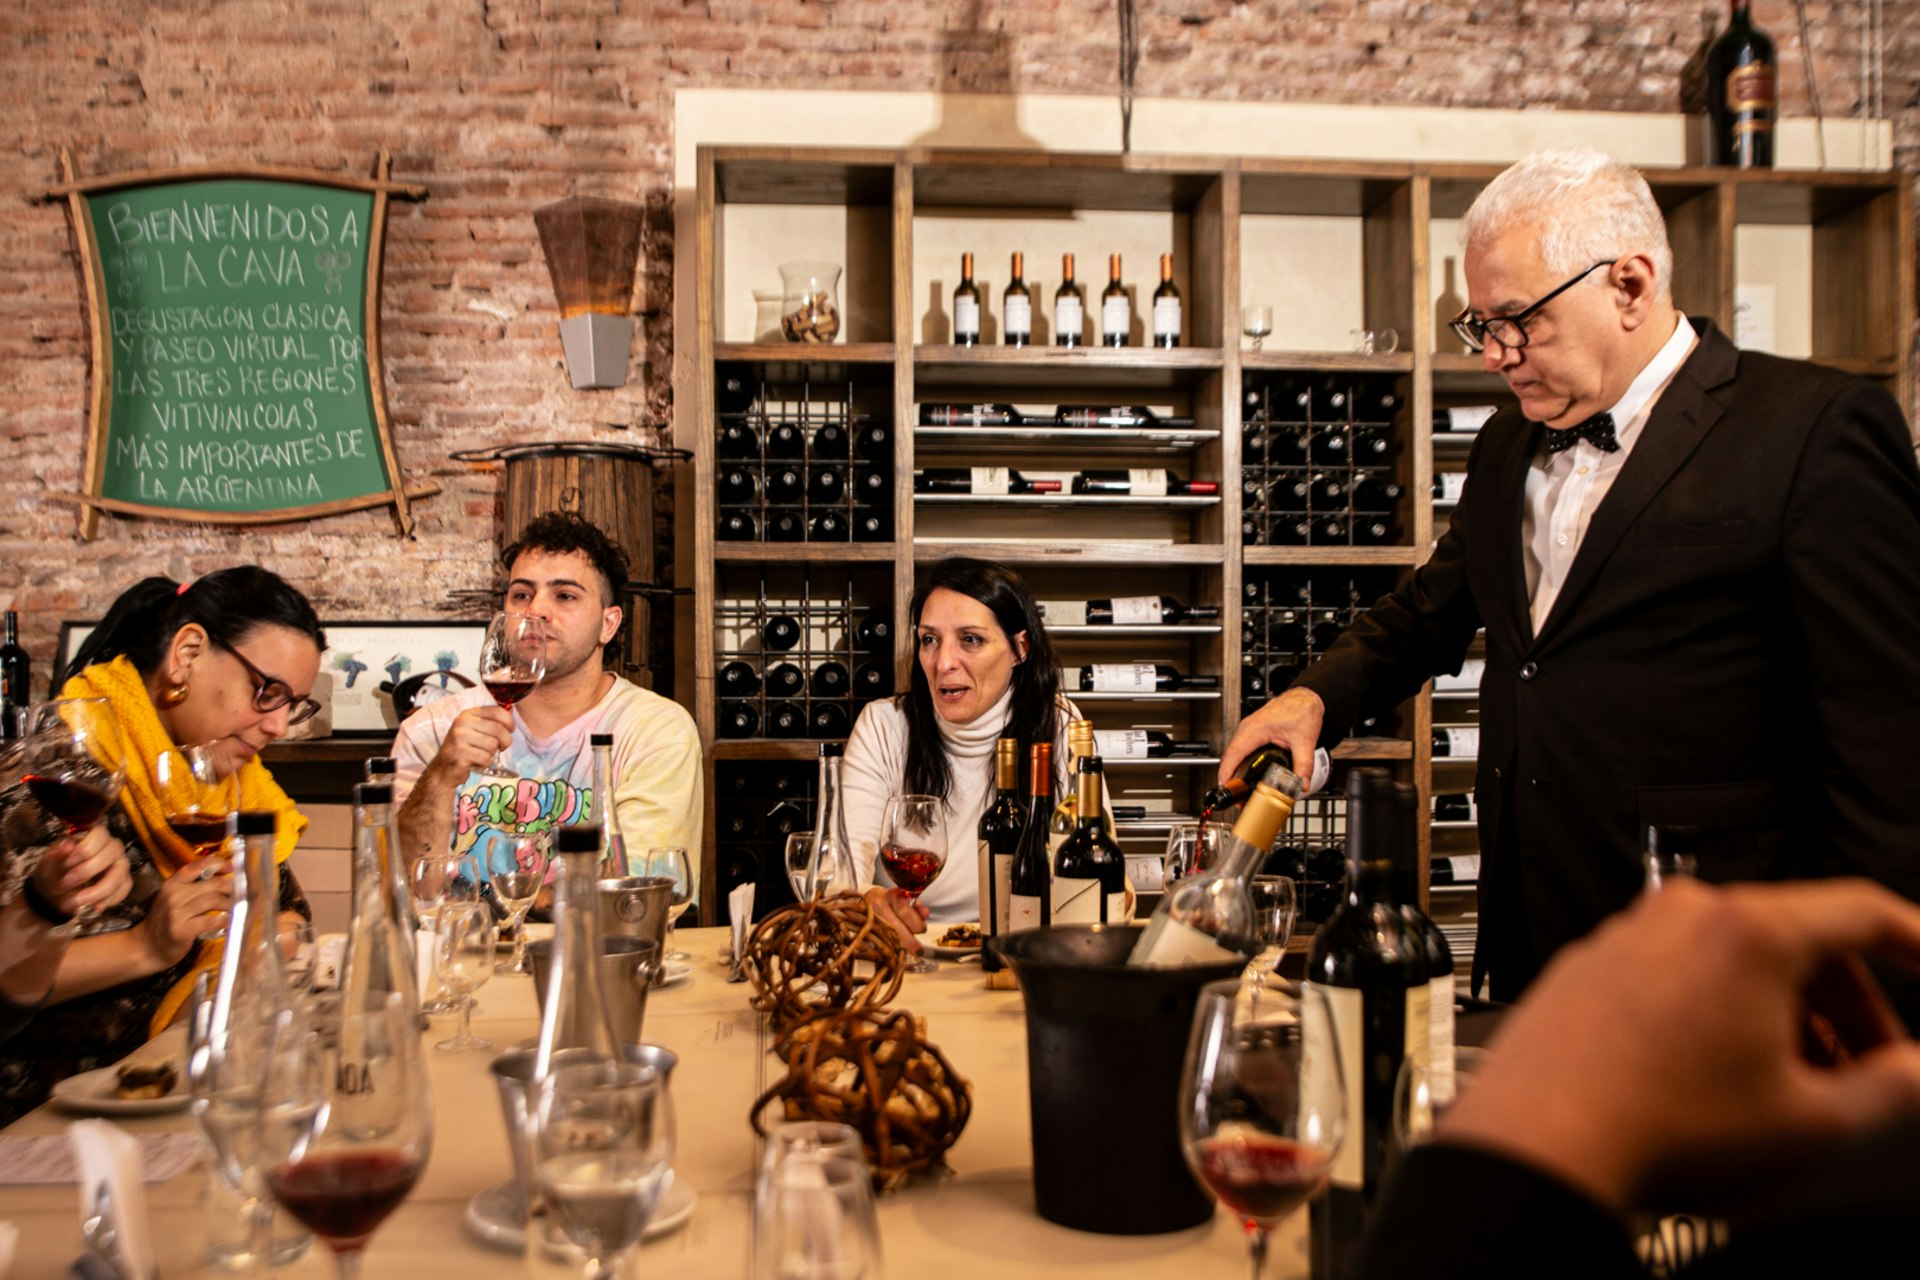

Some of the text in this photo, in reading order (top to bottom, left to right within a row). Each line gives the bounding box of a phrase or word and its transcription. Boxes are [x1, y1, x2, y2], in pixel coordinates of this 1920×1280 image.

[339, 208, 359, 248] A
[157, 244, 305, 293] LA CAVA
[142, 335, 216, 365] PASEO
[222, 331, 320, 364] VIRTUAL
[117, 362, 357, 398] LAS TRES REGIONES
[179, 432, 333, 475] IMPORTANTES
[336, 428, 366, 458] DE
[139, 470, 323, 504] LA ARGENTINA
